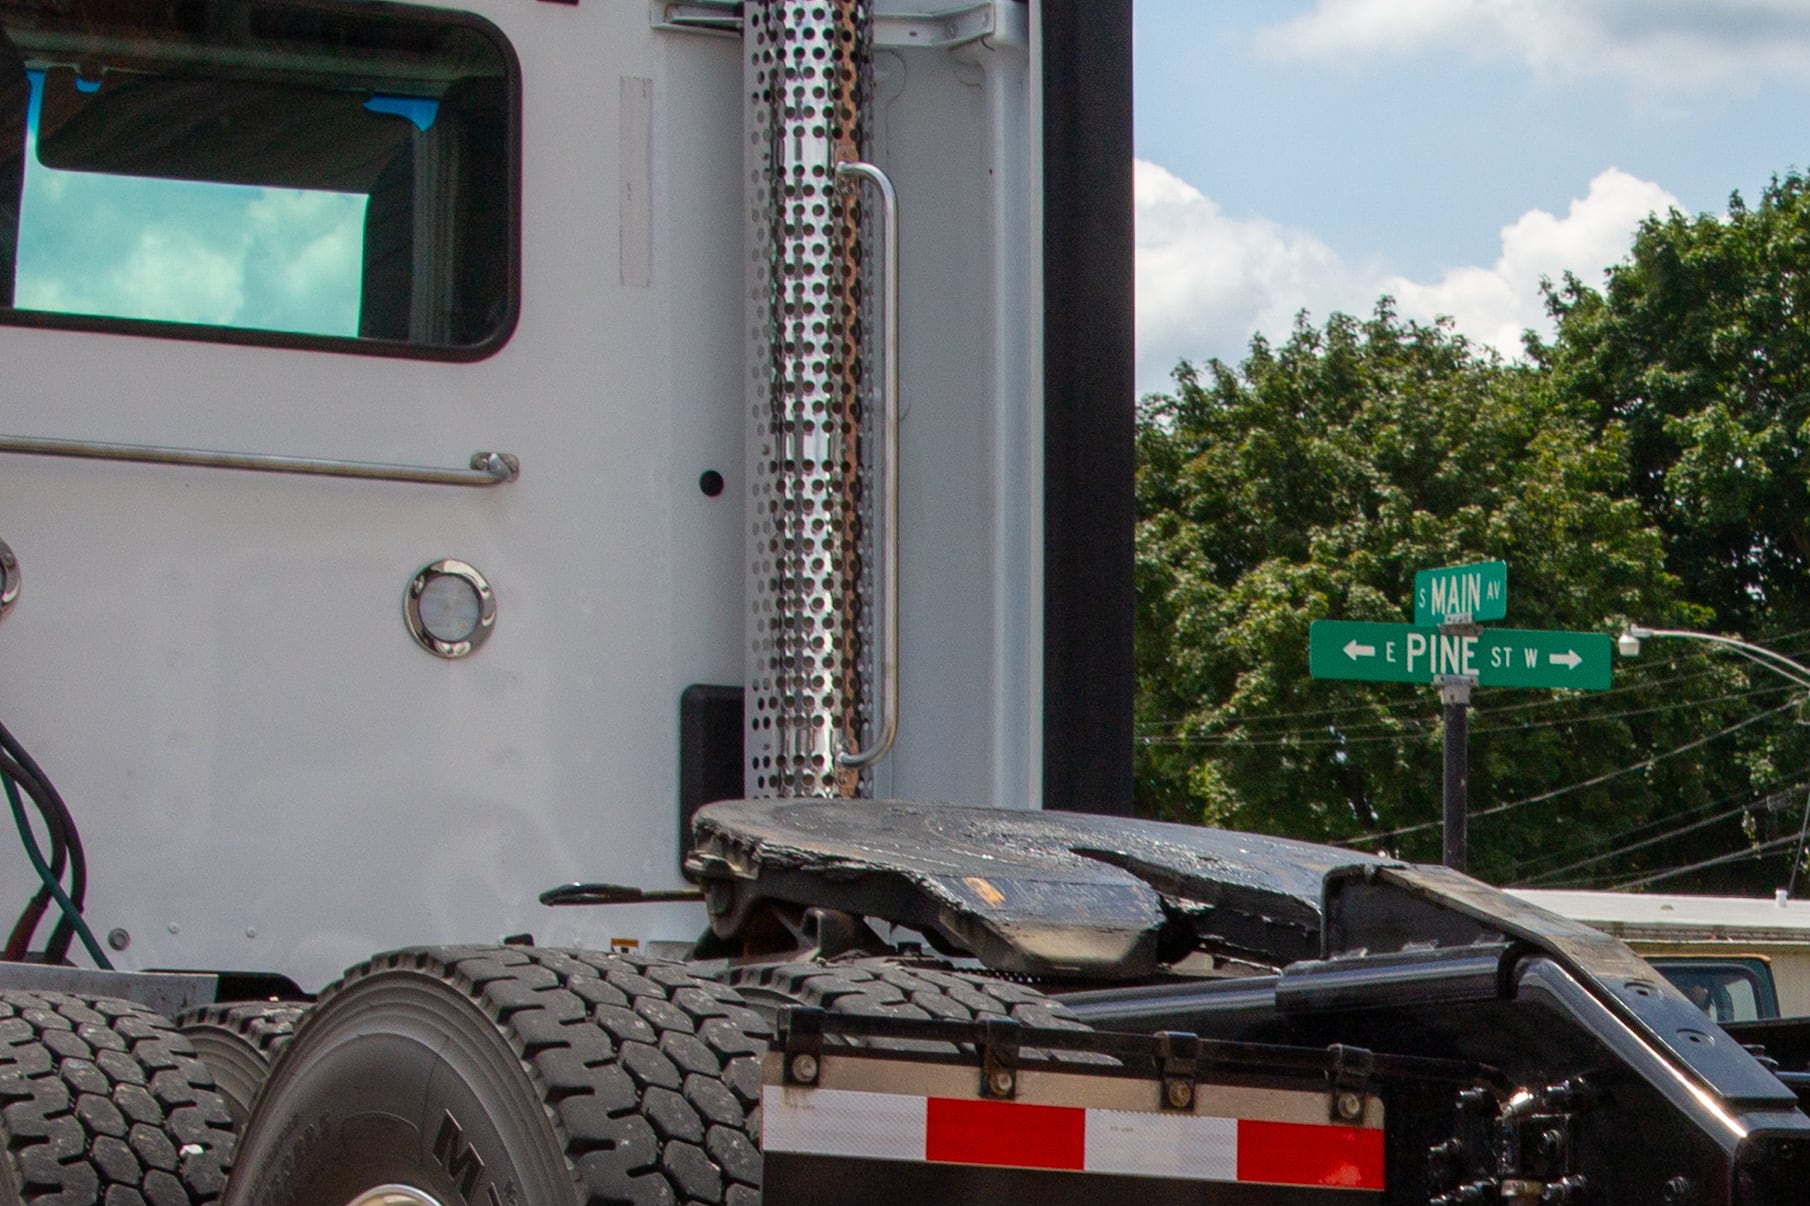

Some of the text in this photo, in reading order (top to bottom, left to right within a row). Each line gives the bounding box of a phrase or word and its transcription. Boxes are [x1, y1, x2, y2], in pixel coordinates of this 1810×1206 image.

[1418, 573, 1502, 616] S MAIN AV
[1386, 632, 1538, 676] E PINE ST W
